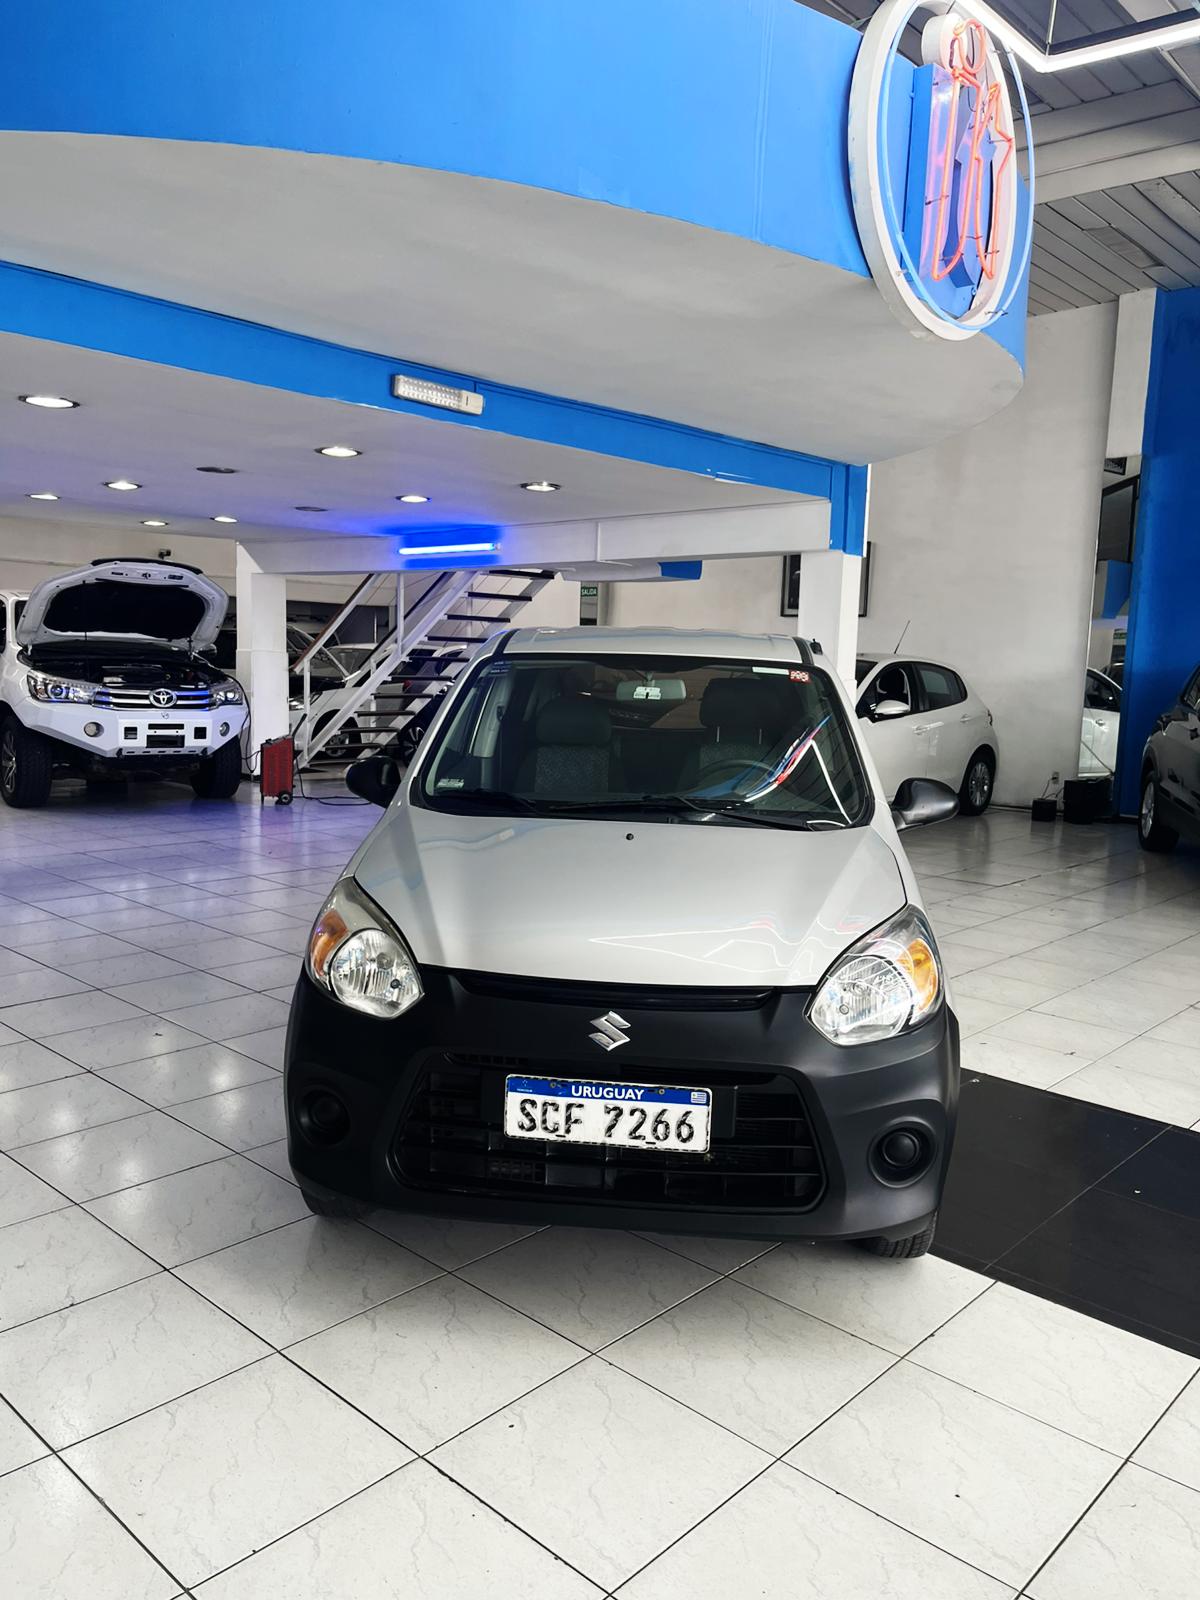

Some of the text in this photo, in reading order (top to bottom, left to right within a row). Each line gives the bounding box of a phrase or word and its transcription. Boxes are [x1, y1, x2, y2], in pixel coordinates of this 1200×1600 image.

[581, 588, 597, 596] SALIDA
[571, 1085, 645, 1100] URUGUAY
[517, 1098, 695, 1144] SCF 7266
